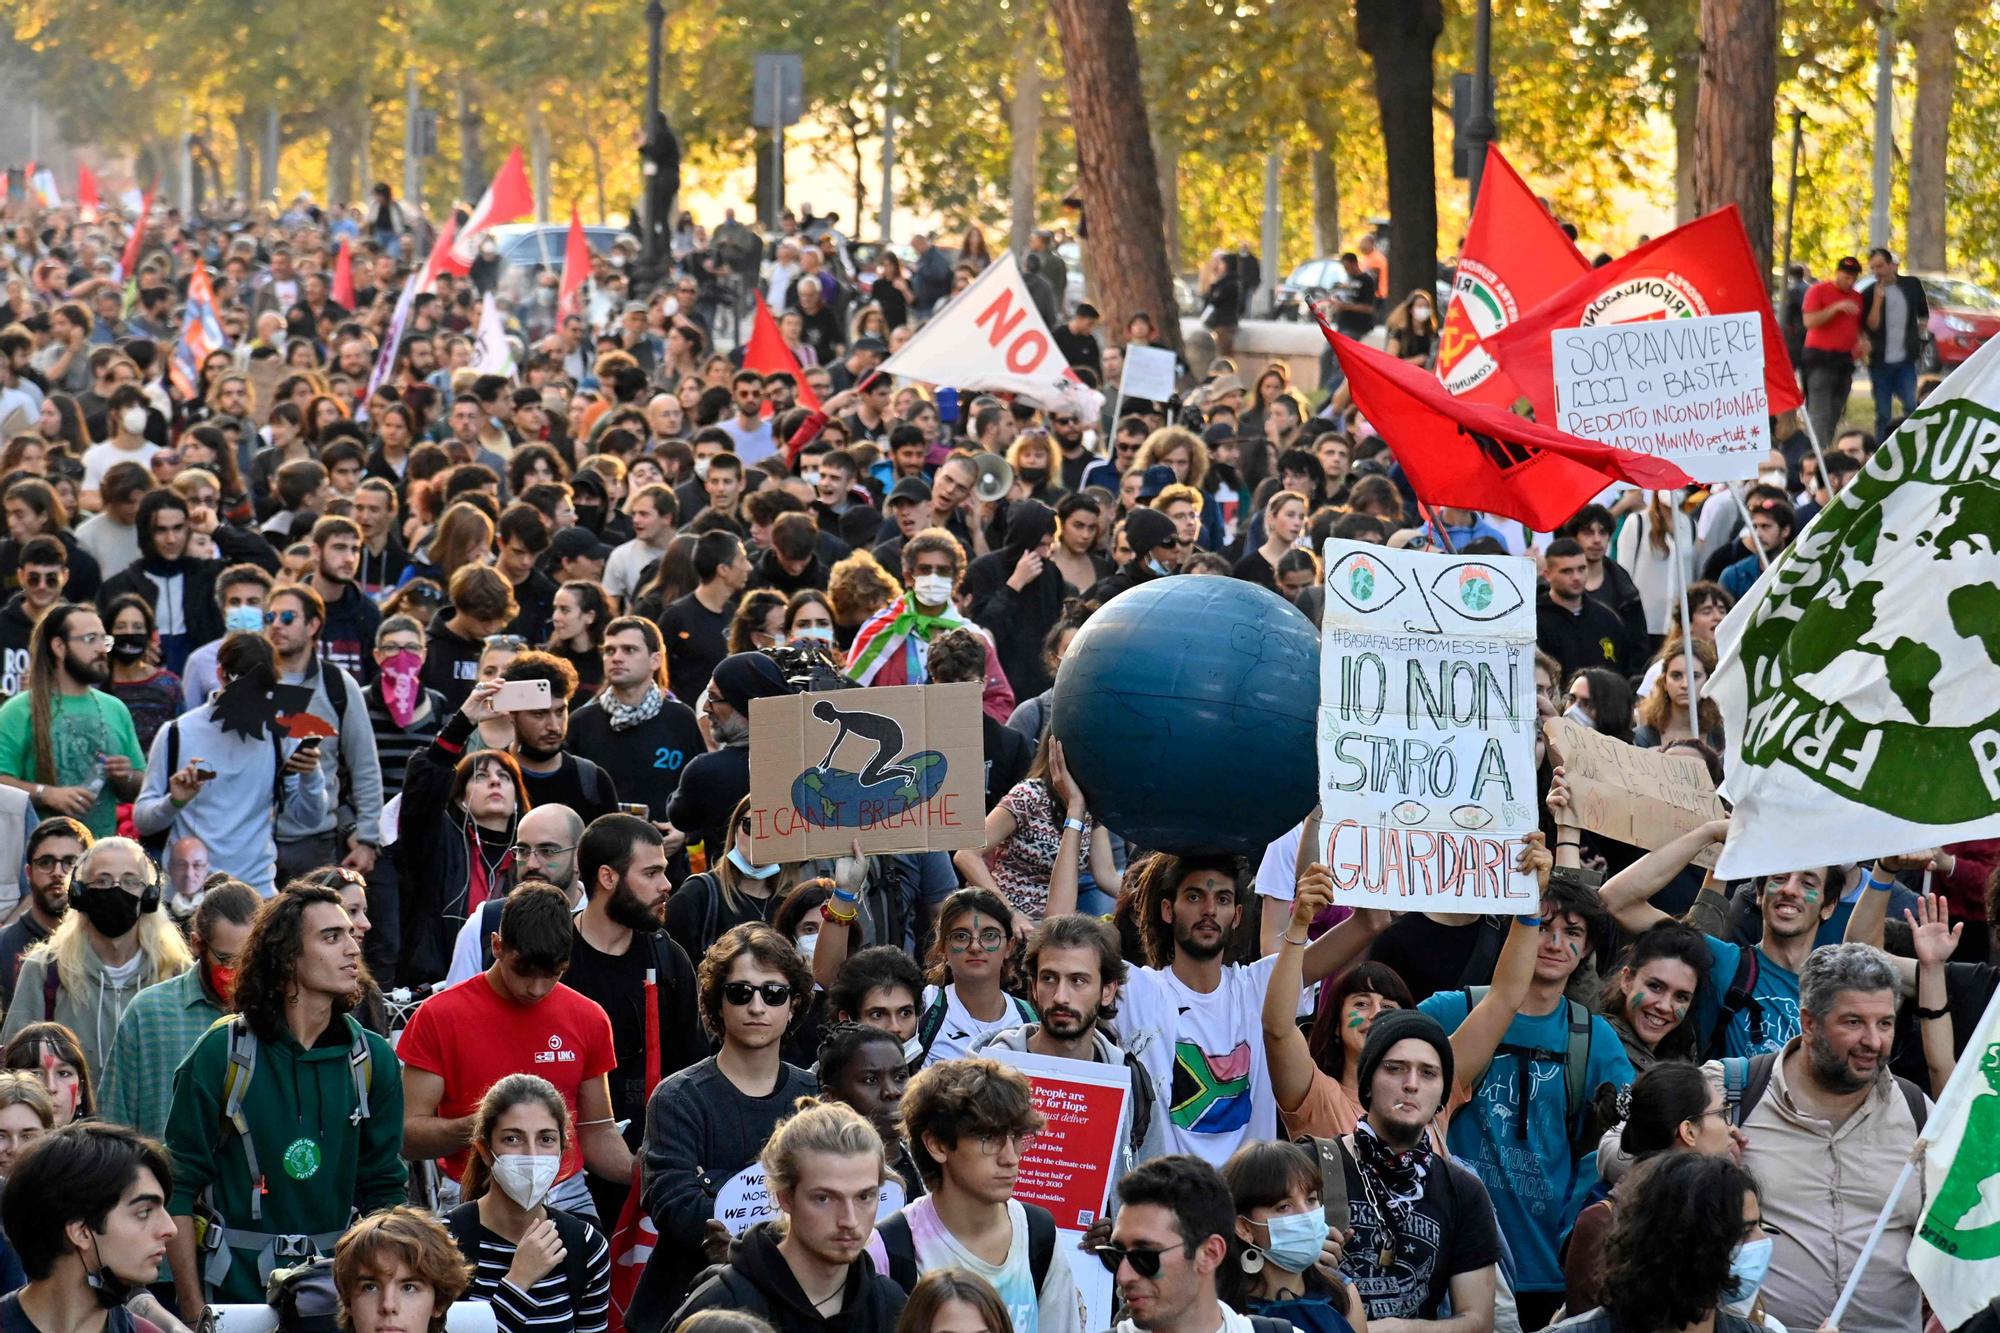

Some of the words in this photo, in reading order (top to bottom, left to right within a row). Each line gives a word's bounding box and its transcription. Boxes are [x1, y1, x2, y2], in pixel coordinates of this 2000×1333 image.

[974, 287, 1049, 375] NO
[1566, 320, 1757, 375] SOPRAVVIVERE
[1568, 406, 1648, 438] REDDITO
[1333, 631, 1501, 654] #BASTAFALSEPROMESSE
[1341, 652, 1387, 726] IO
[1407, 659, 1520, 733] NON
[653, 747, 684, 770] 20
[1470, 737, 1515, 801] A
[754, 809, 770, 839] I
[858, 794, 962, 832] BREATHE
[1327, 817, 1531, 899] GUARDARE
[1035, 1086, 1067, 1099] People
[1068, 1092, 1085, 1102] are
[1046, 1098, 1061, 1109] for
[1062, 1101, 1088, 1113] Hope
[1060, 1112, 1090, 1125] deliver
[1044, 1130, 1055, 1138] for
[1055, 1131, 1066, 1139] All
[1047, 1145, 1063, 1153] Debt
[1023, 1155, 1043, 1164] tackle
[1043, 1157, 1055, 1166] the
[1055, 1159, 1080, 1169] climate
[1079, 1162, 1097, 1171] crisis
[1500, 1145, 1541, 1174] MORE
[1034, 1170, 1050, 1178] least
[1050, 1171, 1064, 1180] half
[1064, 1173, 1073, 1181] of
[1036, 1179, 1045, 1187] by
[1045, 1180, 1064, 1189] 2030
[1012, 1190, 1036, 1199] armful
[1036, 1193, 1066, 1203] subsidies
[725, 1206, 747, 1219] WE
